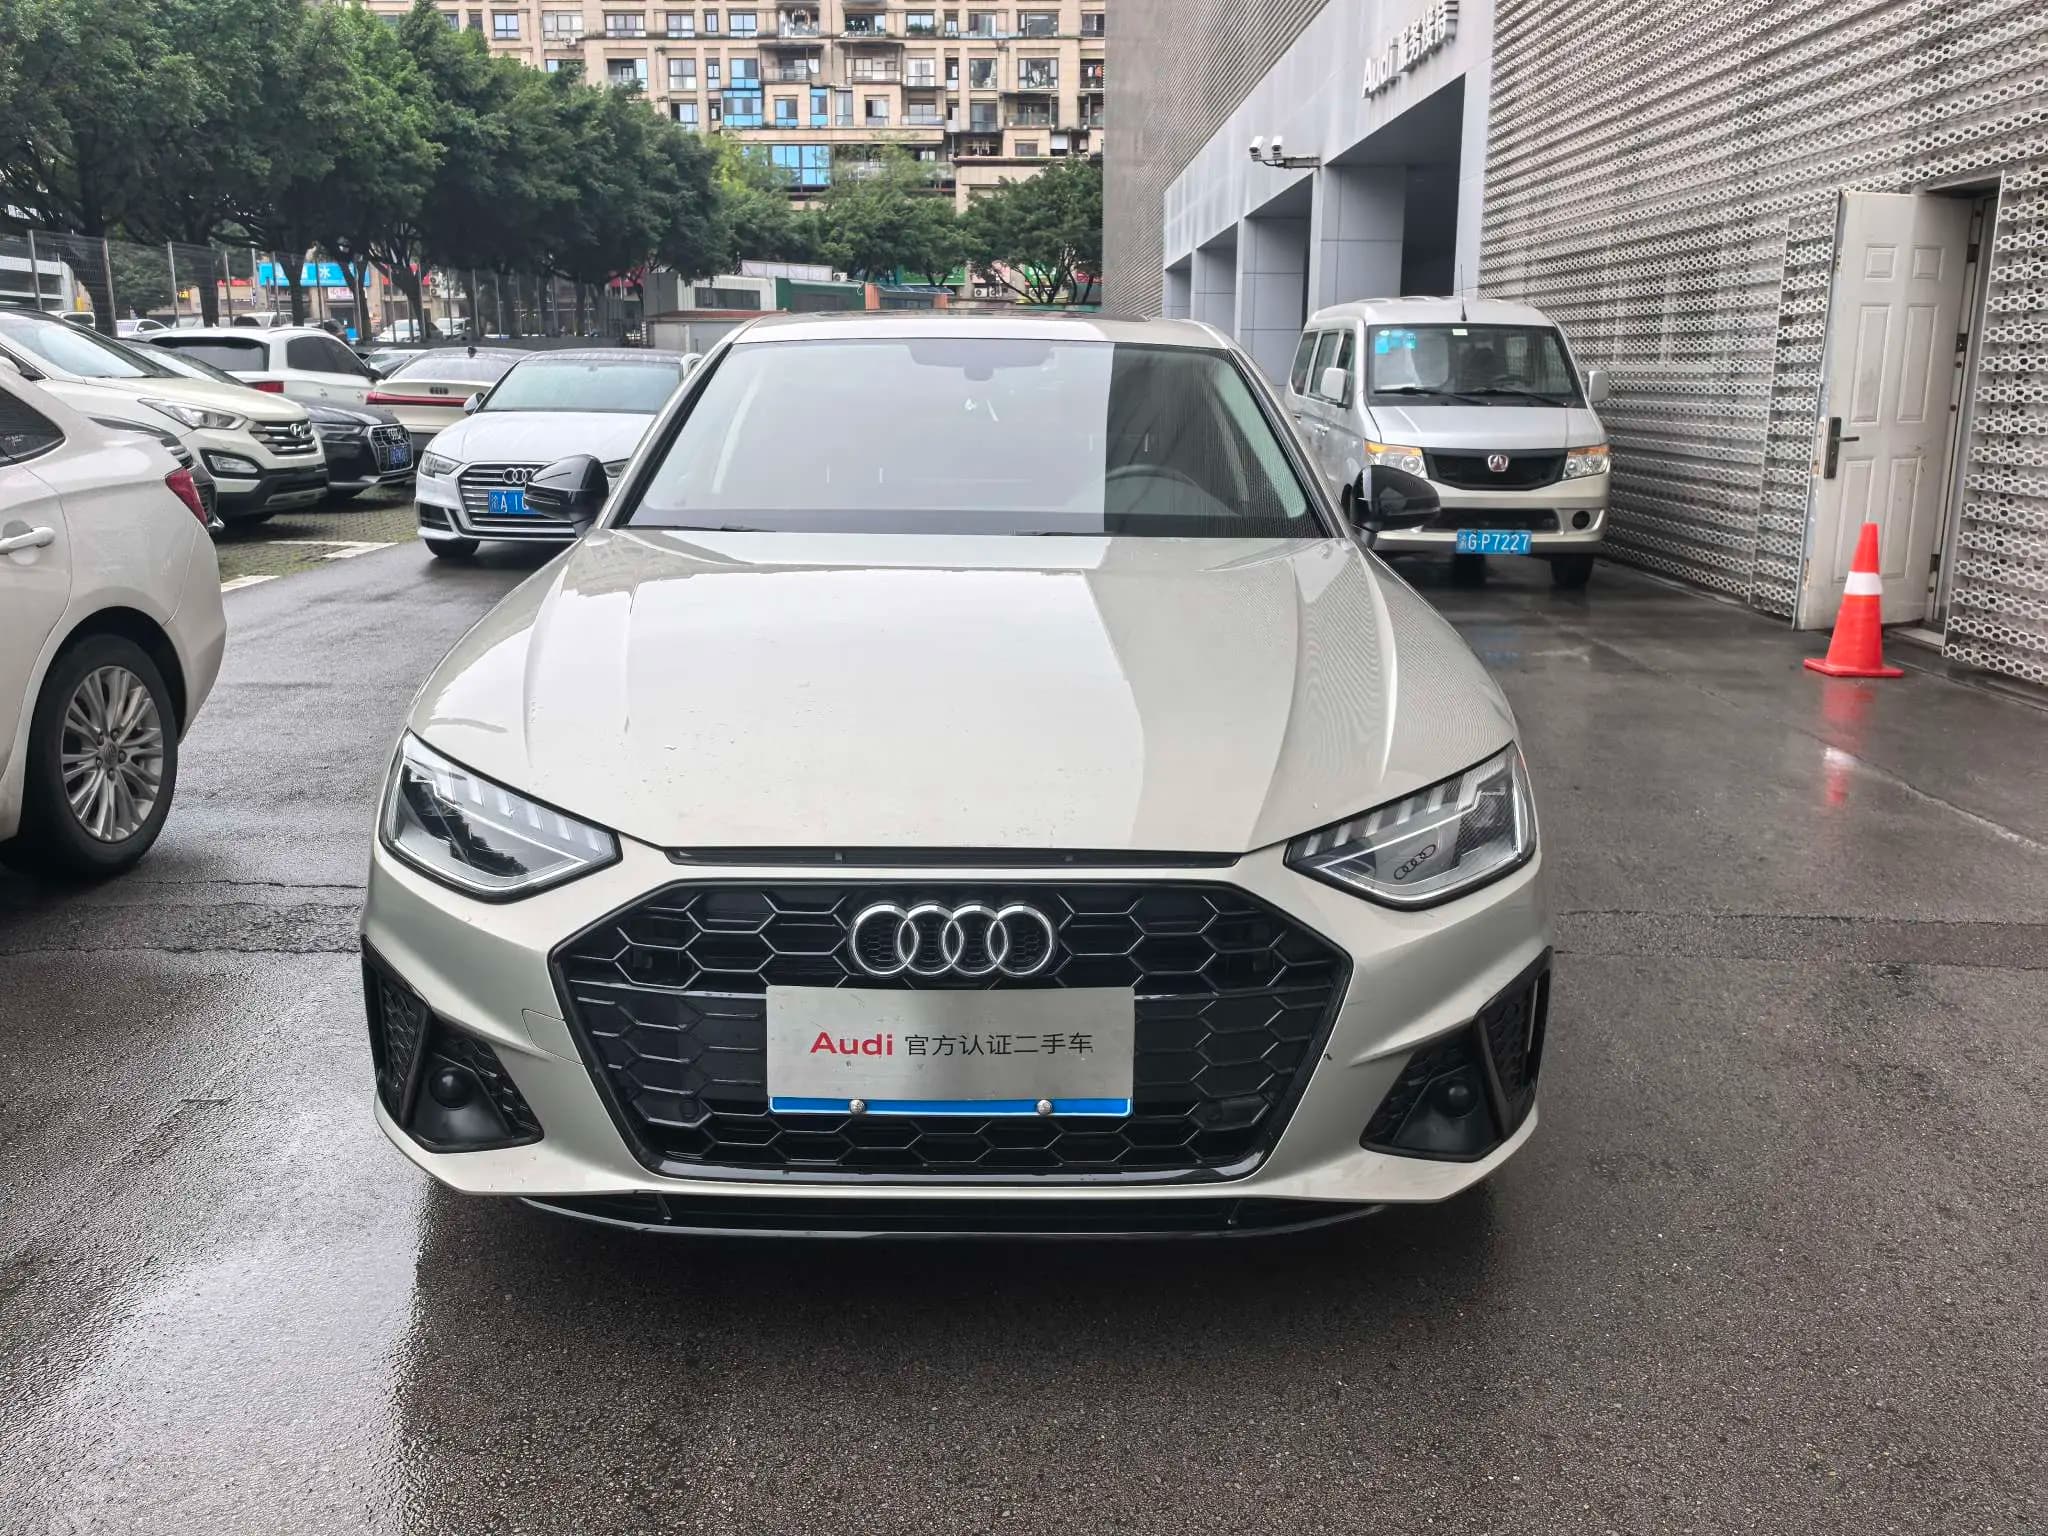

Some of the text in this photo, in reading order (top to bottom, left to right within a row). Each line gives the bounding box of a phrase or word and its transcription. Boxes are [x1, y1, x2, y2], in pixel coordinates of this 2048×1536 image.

[1361, 38, 1395, 98] Audi
[810, 1031, 1094, 1057] Audi 官方认证二手车
